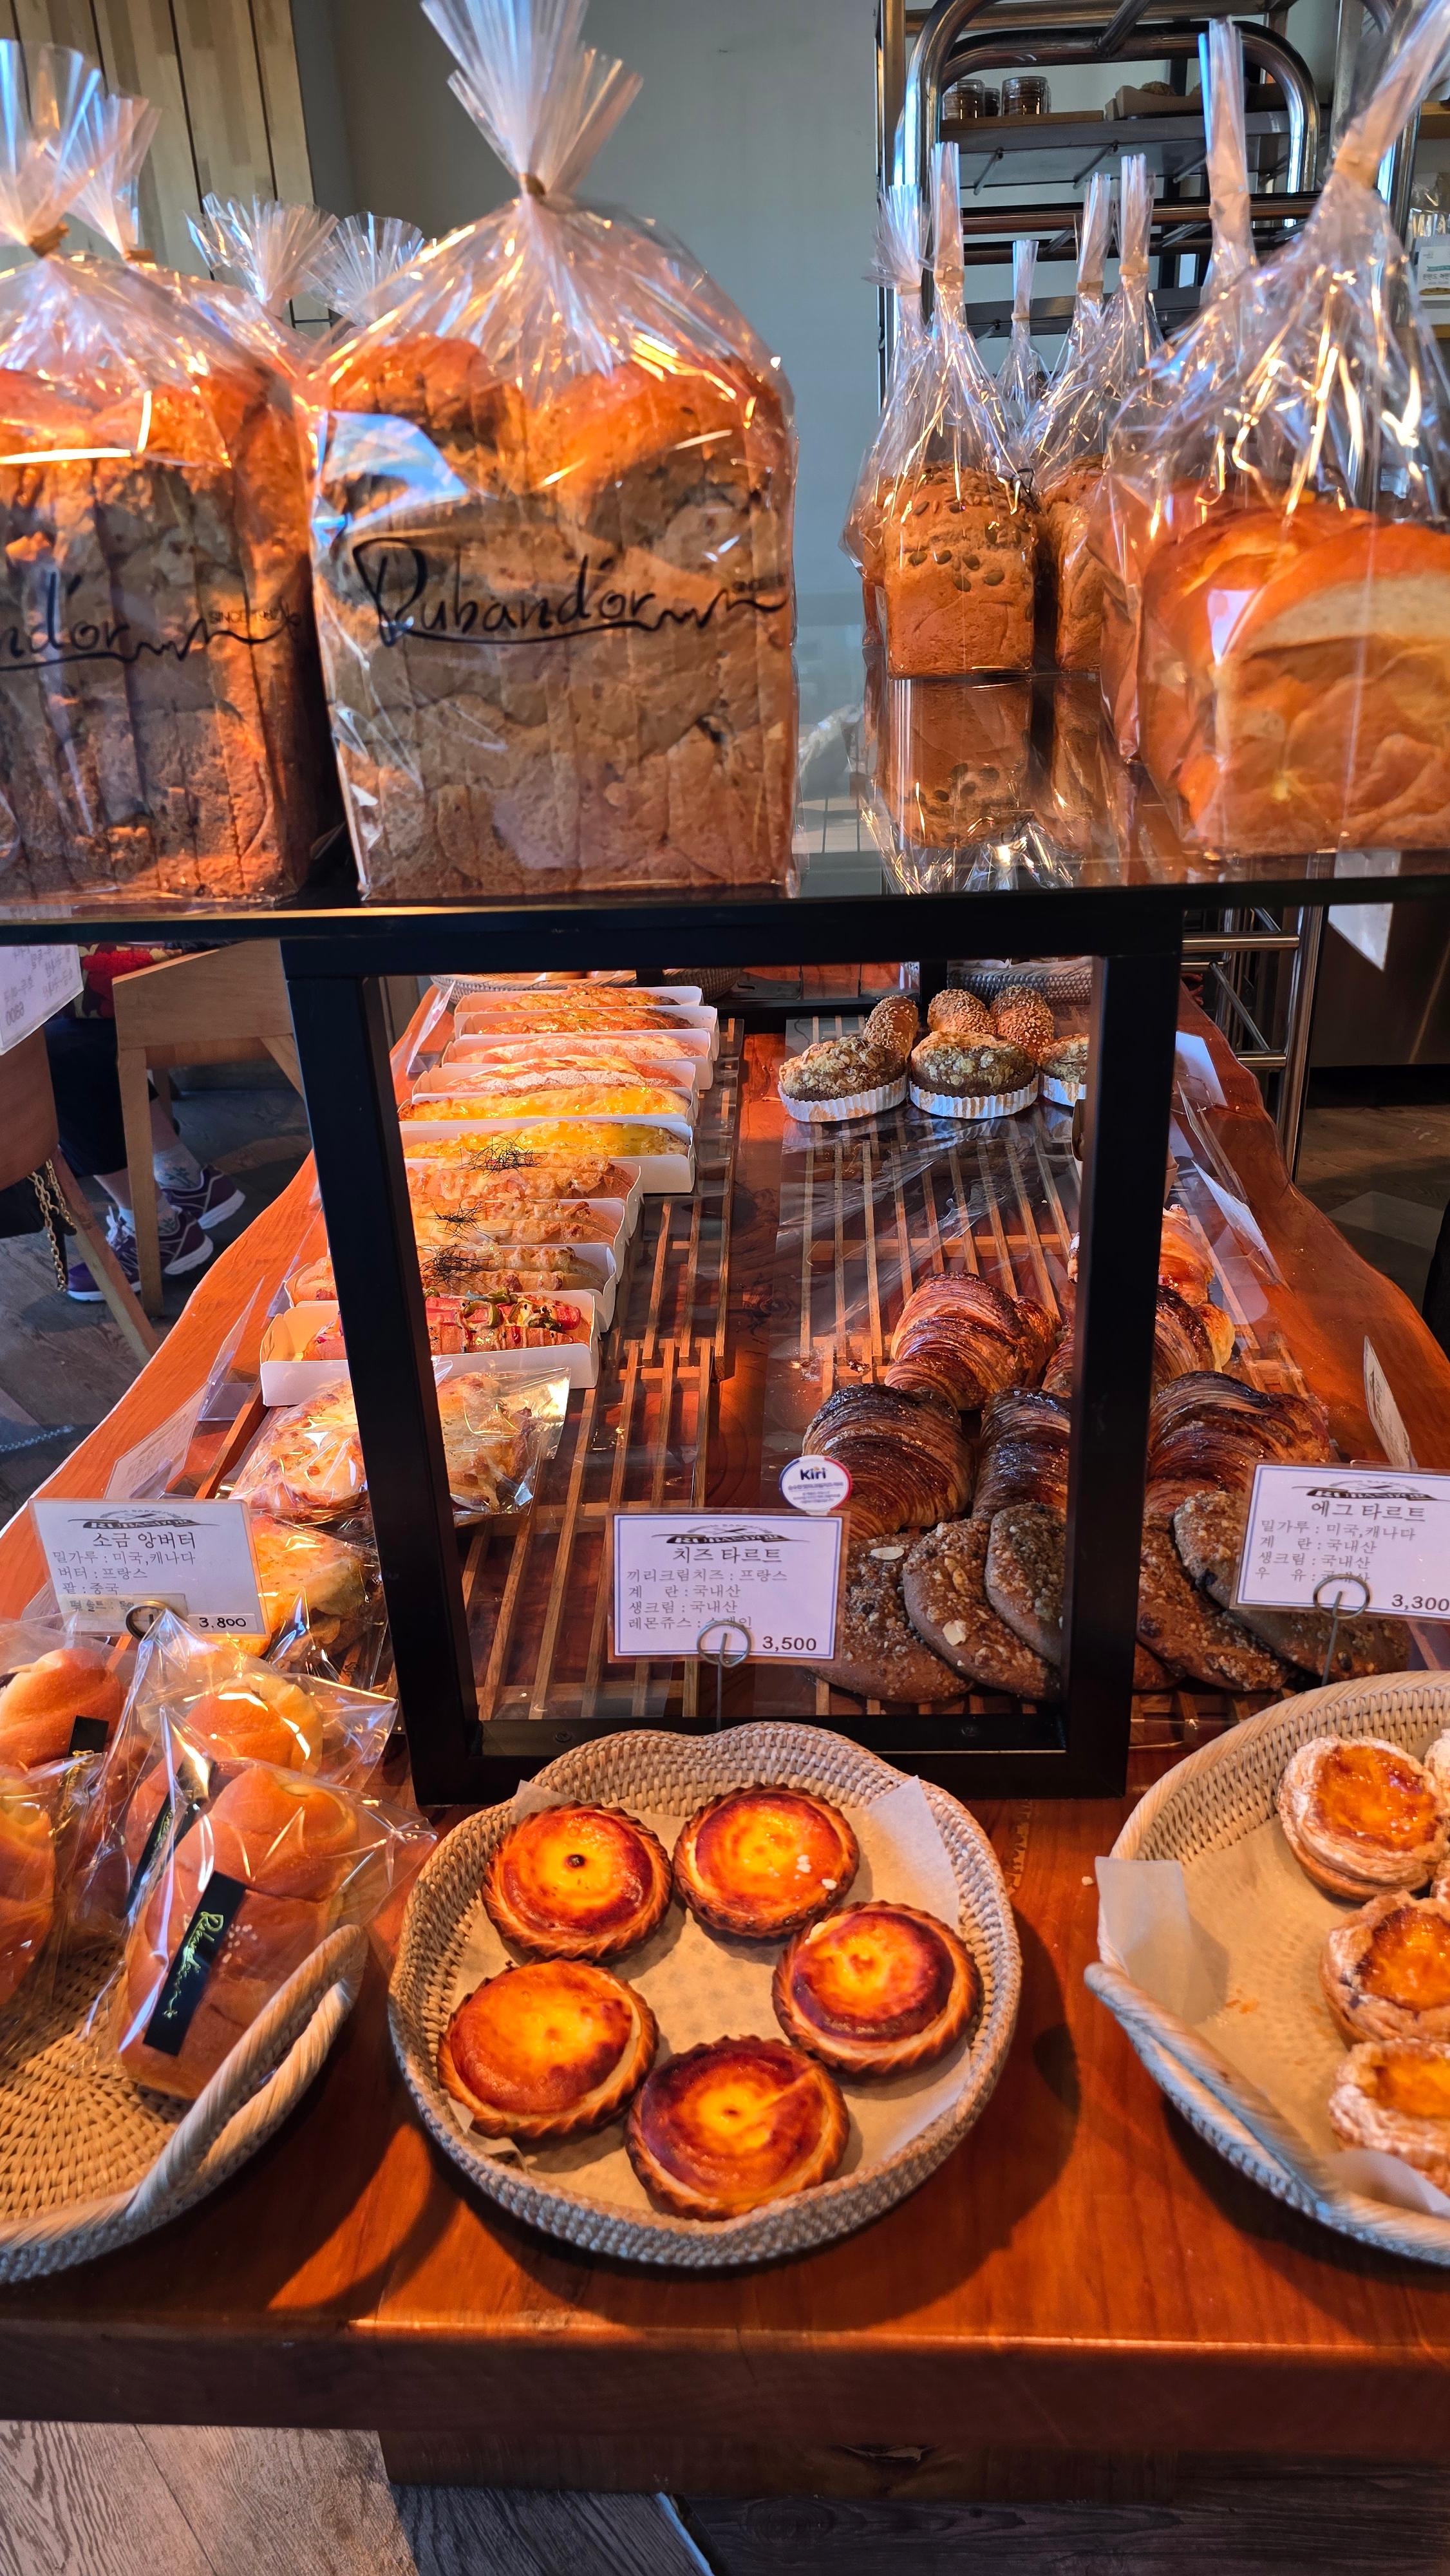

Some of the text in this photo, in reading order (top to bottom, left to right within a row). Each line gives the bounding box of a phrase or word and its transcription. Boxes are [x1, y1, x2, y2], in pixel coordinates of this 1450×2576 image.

[800, 1467, 827, 1480] Kiri
[1312, 1501, 1426, 1522] 에그 타르트
[1261, 1520, 1308, 1534] 밀가루
[1326, 1522, 1415, 1540] 미국,캐나다
[93, 1532, 196, 1549] 소금 앙버터
[1259, 1535, 1274, 1547] 계
[1297, 1537, 1313, 1550] 란
[1327, 1539, 1377, 1554] 국내산
[53, 1551, 98, 1564] 밀가루
[113, 1551, 196, 1566] 미국,캐나다
[673, 1547, 782, 1564] 치즈 타르트
[1258, 1552, 1305, 1566] 생크림
[1321, 1555, 1370, 1569] 국내산
[59, 1567, 88, 1580] 버터
[102, 1567, 147, 1580] 프랑스
[626, 1569, 724, 1582] 끼리크림치즈
[739, 1569, 787, 1582] 프랑스
[1255, 1567, 1270, 1579] 우
[1291, 1569, 1306, 1582] 유
[62, 1582, 76, 1594] 팥
[90, 1583, 119, 1595] 중국
[628, 1585, 642, 1598] 계
[665, 1585, 679, 1598] 란
[693, 1585, 740, 1598] 국내산
[628, 1601, 674, 1614] 생크림
[690, 1601, 737, 1614] 국내산
[1391, 1594, 1450, 1611] 3,300
[628, 1617, 692, 1630] 레몬쥬스
[762, 1636, 816, 1651] 3,500
